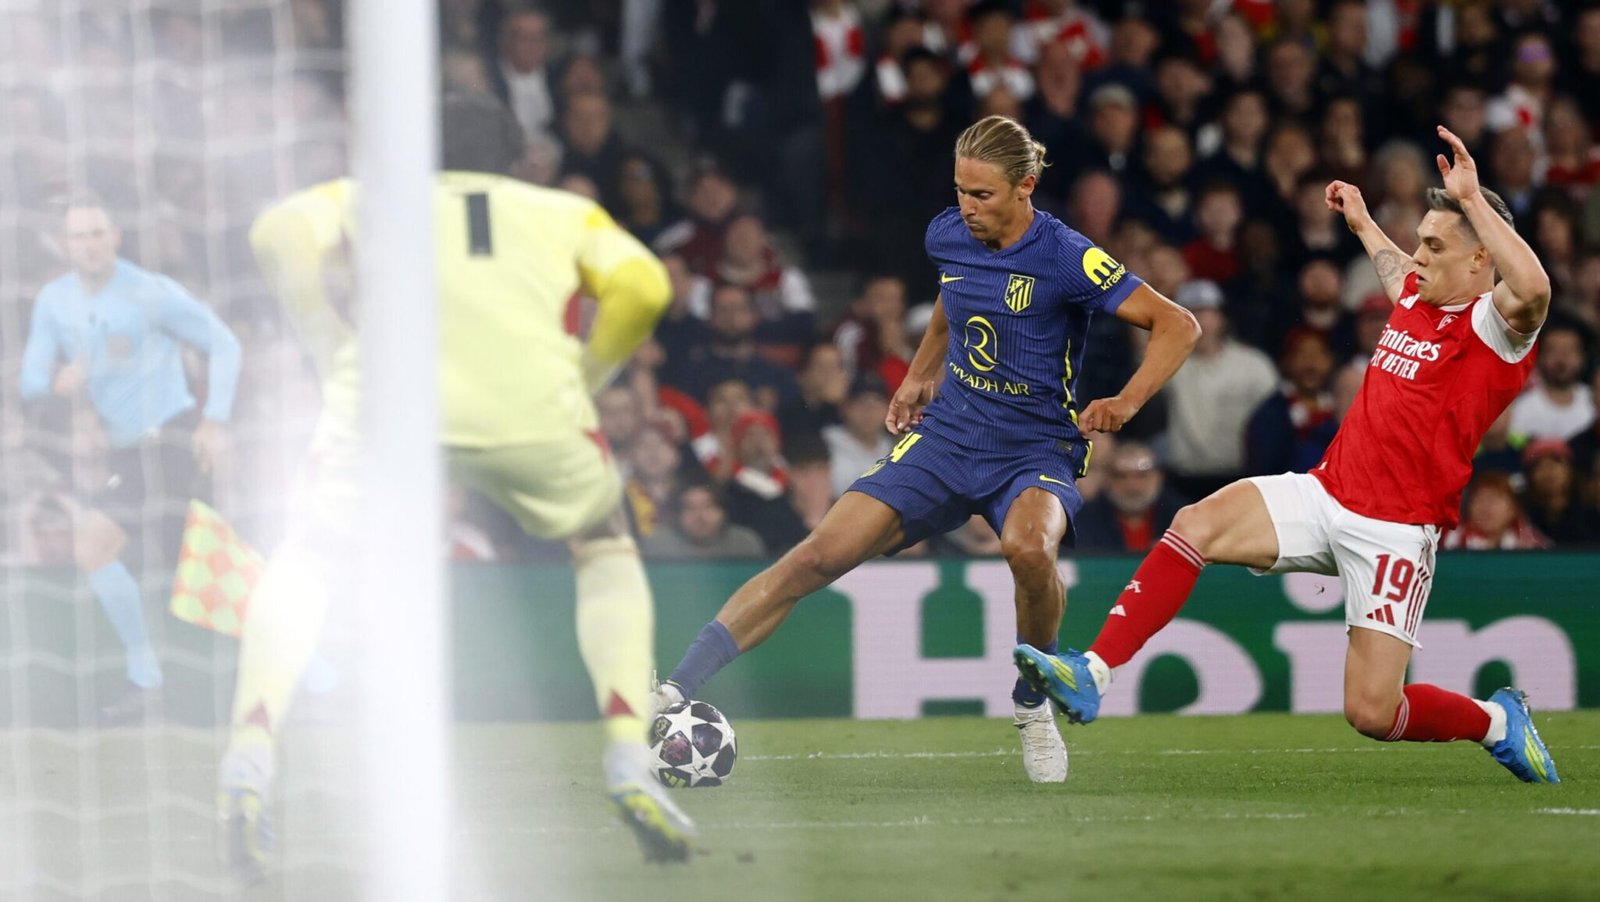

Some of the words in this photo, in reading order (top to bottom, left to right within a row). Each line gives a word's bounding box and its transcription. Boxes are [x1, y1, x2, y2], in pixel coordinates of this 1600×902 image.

[462, 191, 493, 258] 1
[1100, 263, 1126, 291] krake
[1381, 352, 1421, 381] BETTER
[1002, 381, 1031, 396] AIR
[1371, 553, 1415, 604] 19
